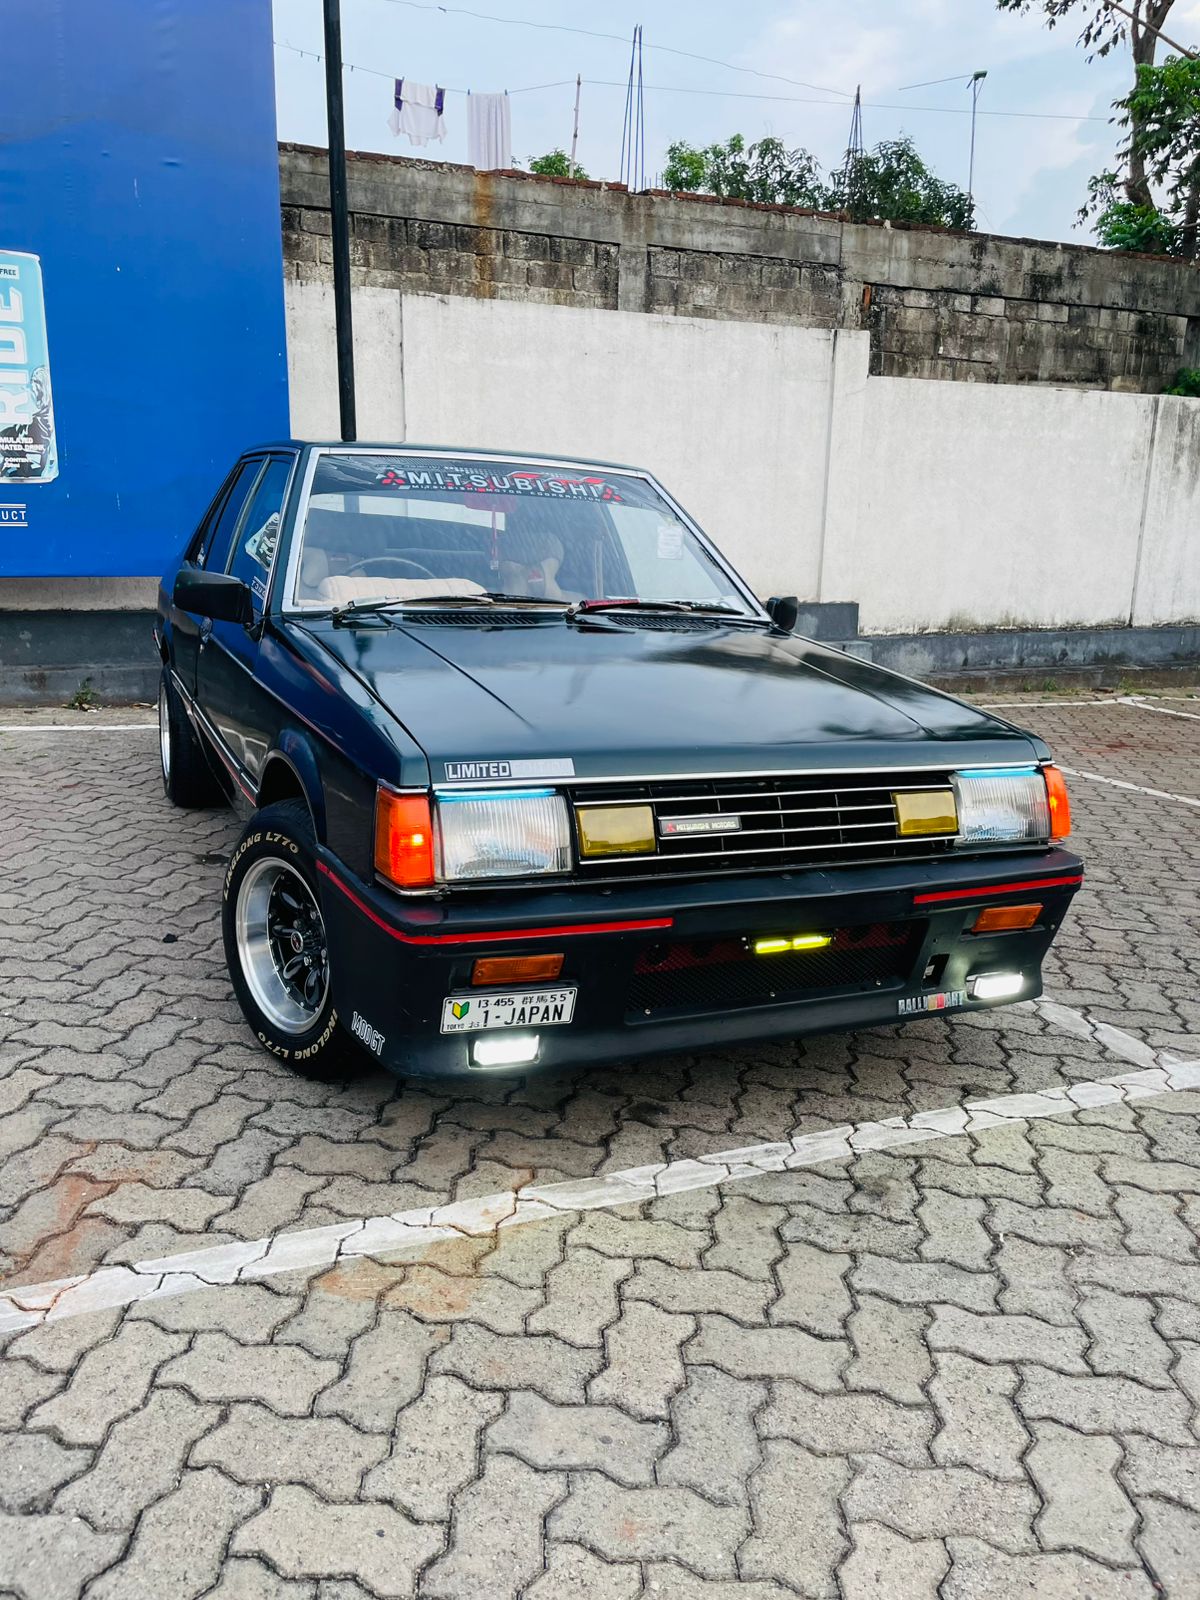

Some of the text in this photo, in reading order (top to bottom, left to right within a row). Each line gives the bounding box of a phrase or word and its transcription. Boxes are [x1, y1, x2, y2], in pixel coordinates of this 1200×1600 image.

[407, 471, 599, 498] MITSUBISHI
[0, 510, 27, 520] UCT
[448, 762, 510, 779] LIMITED
[265, 831, 299, 854] L770
[294, 1008, 338, 1060] INGLONG
[351, 1010, 386, 1056] 1400GT
